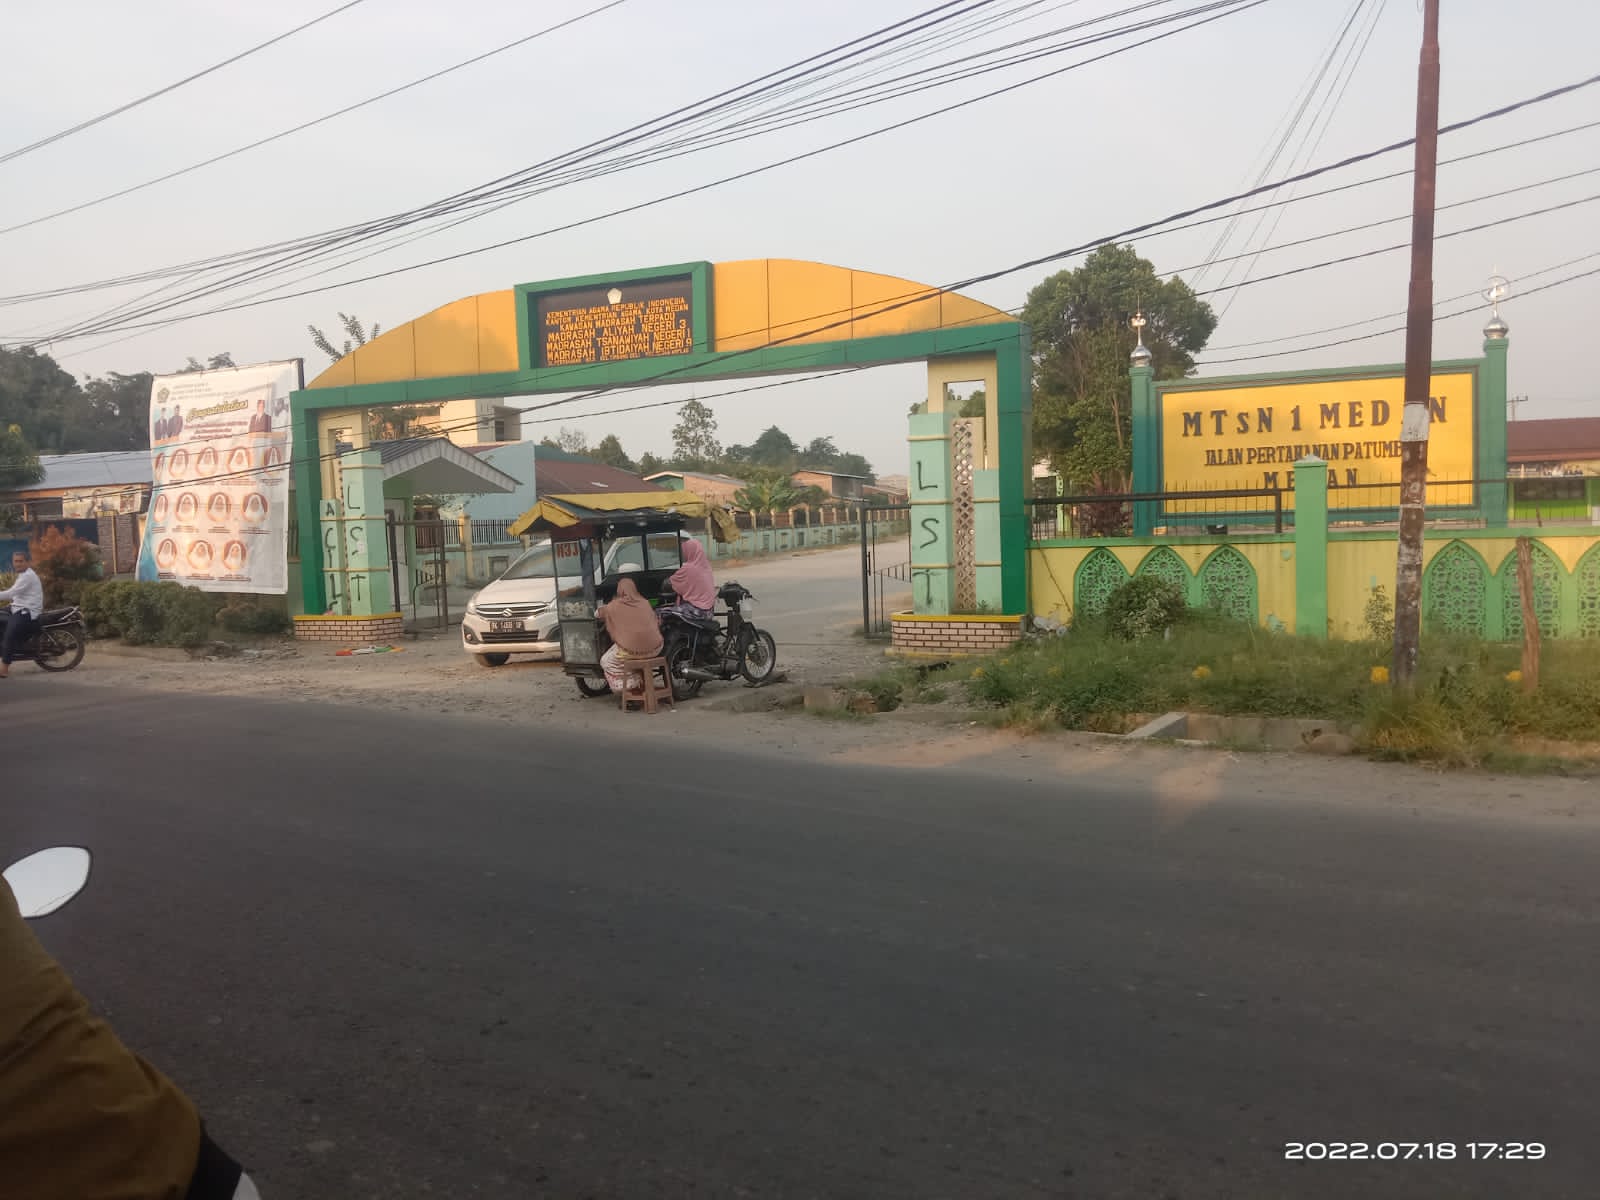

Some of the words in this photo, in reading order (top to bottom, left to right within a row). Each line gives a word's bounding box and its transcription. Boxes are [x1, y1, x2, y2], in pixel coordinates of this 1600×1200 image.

[546, 317, 571, 325] KANTOR
[646, 306, 664, 314] KOTA
[666, 303, 688, 312] MEDAN
[589, 306, 609, 314] AGAMA
[612, 302, 644, 311] REPUBLIK
[648, 297, 685, 307] INDONESIA
[548, 328, 596, 342] MADRASAH
[603, 325, 634, 337] ALIYAH
[642, 320, 675, 332] NEGERI
[680, 319, 687, 329] 3
[560, 321, 593, 331] KAWASAN
[595, 316, 636, 328] MADRASAH
[638, 312, 675, 323] TERPADU
[547, 338, 592, 351] MADRASAH
[596, 333, 649, 347] TSANAWIYAH
[654, 329, 685, 341] NEGERI
[547, 348, 595, 361] MADRASAH
[601, 342, 649, 356] IBTIDAIYAH
[652, 338, 684, 352] NEGERI
[685, 338, 692, 346] 9
[1291, 405, 1302, 432] 1
[1319, 396, 1447, 430] MEDN
[1204, 447, 1243, 467] JALAN
[1263, 467, 1358, 490] MEAN
